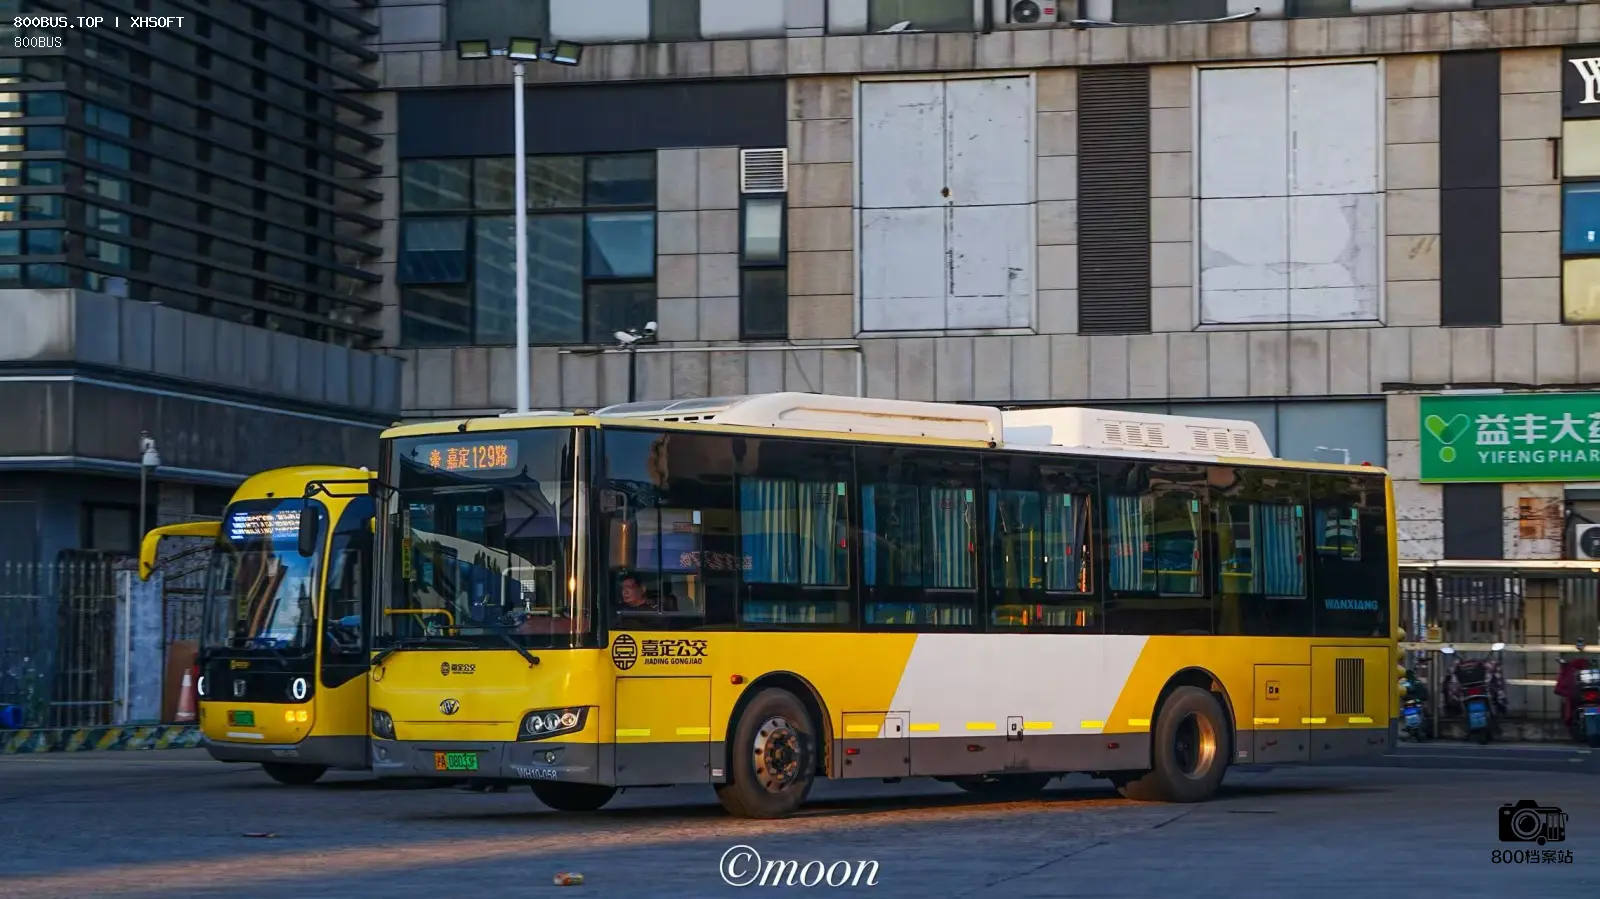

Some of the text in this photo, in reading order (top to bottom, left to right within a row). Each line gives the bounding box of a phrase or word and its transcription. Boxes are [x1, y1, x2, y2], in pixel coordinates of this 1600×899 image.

[446, 444, 508, 470] 嘉定129路
[1478, 450, 1545, 464] YIFENG
[1324, 599, 1379, 611] WANXIANG
[641, 639, 708, 657] 嘉定公交
[644, 657, 703, 665] JIADING GONGJIAO
